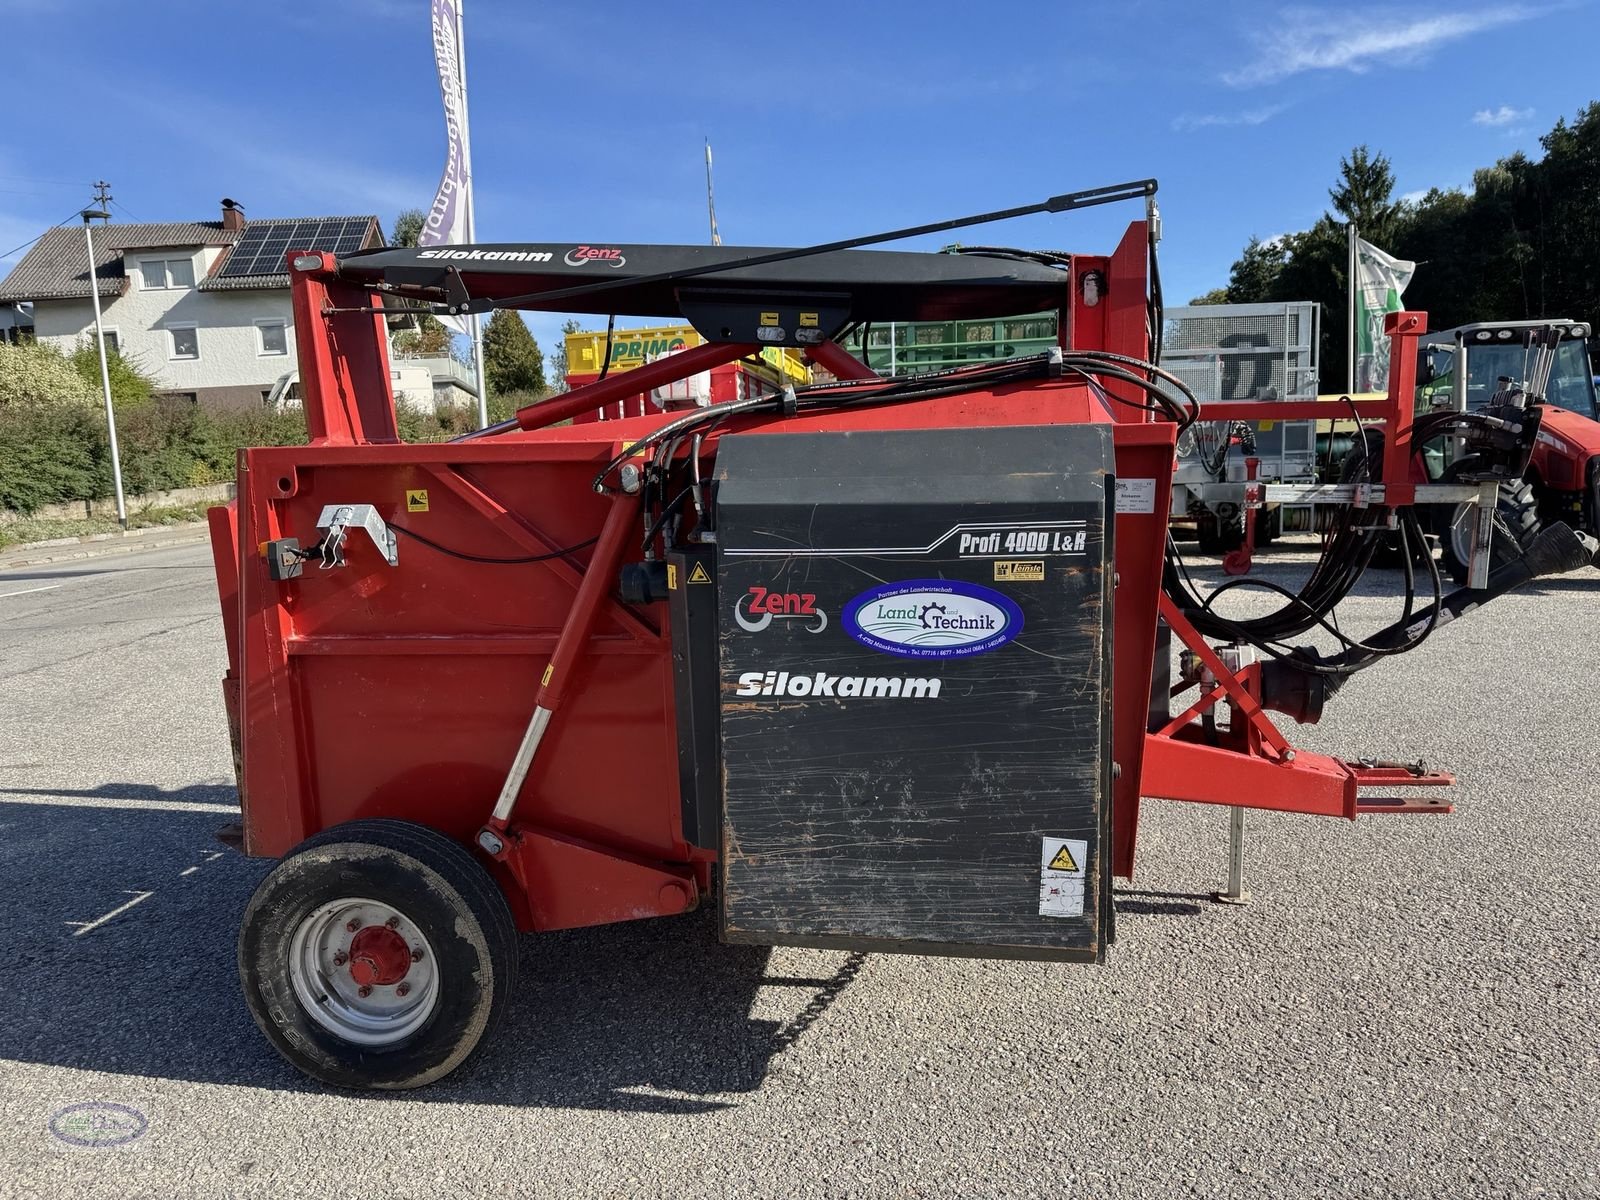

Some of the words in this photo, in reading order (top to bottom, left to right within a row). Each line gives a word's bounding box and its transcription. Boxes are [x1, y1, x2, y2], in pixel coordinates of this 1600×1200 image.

[416, 249, 553, 262] Silokamm
[575, 246, 621, 259] Zenz
[959, 533, 1000, 553] Profi
[1004, 531, 1049, 552] 4000
[1052, 531, 1086, 551] L&R
[749, 587, 816, 614] Zenz
[877, 590, 899, 599] Partner
[877, 604, 918, 619] Land
[932, 615, 995, 630] Technik
[736, 670, 942, 698] Silokamm
